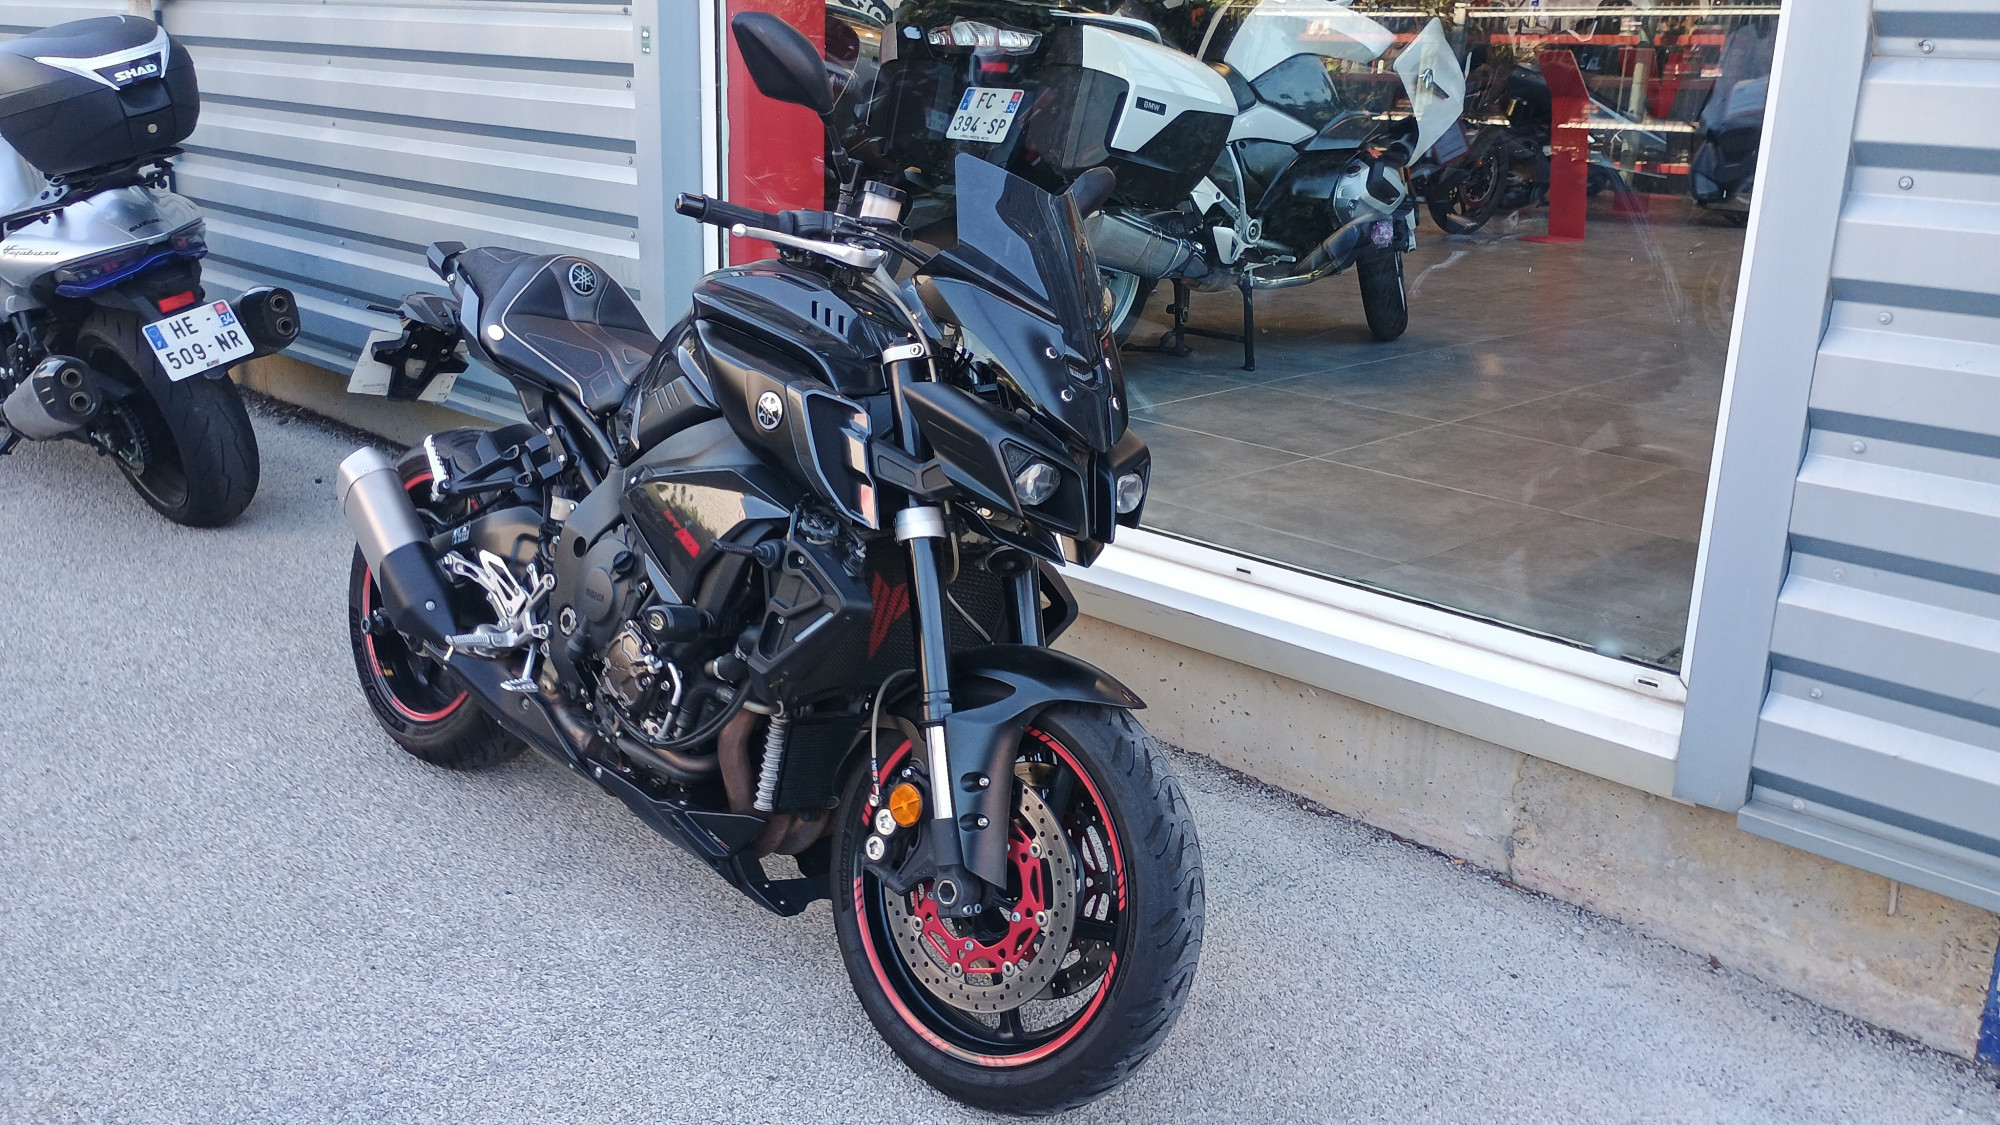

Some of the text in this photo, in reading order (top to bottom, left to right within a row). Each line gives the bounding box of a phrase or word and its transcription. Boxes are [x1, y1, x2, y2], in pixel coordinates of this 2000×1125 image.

[114, 63, 158, 82] SHAD
[976, 92, 997, 109] FC
[1143, 100, 1161, 112] BMW
[169, 316, 199, 339] HE
[165, 329, 244, 370] 509-NR
